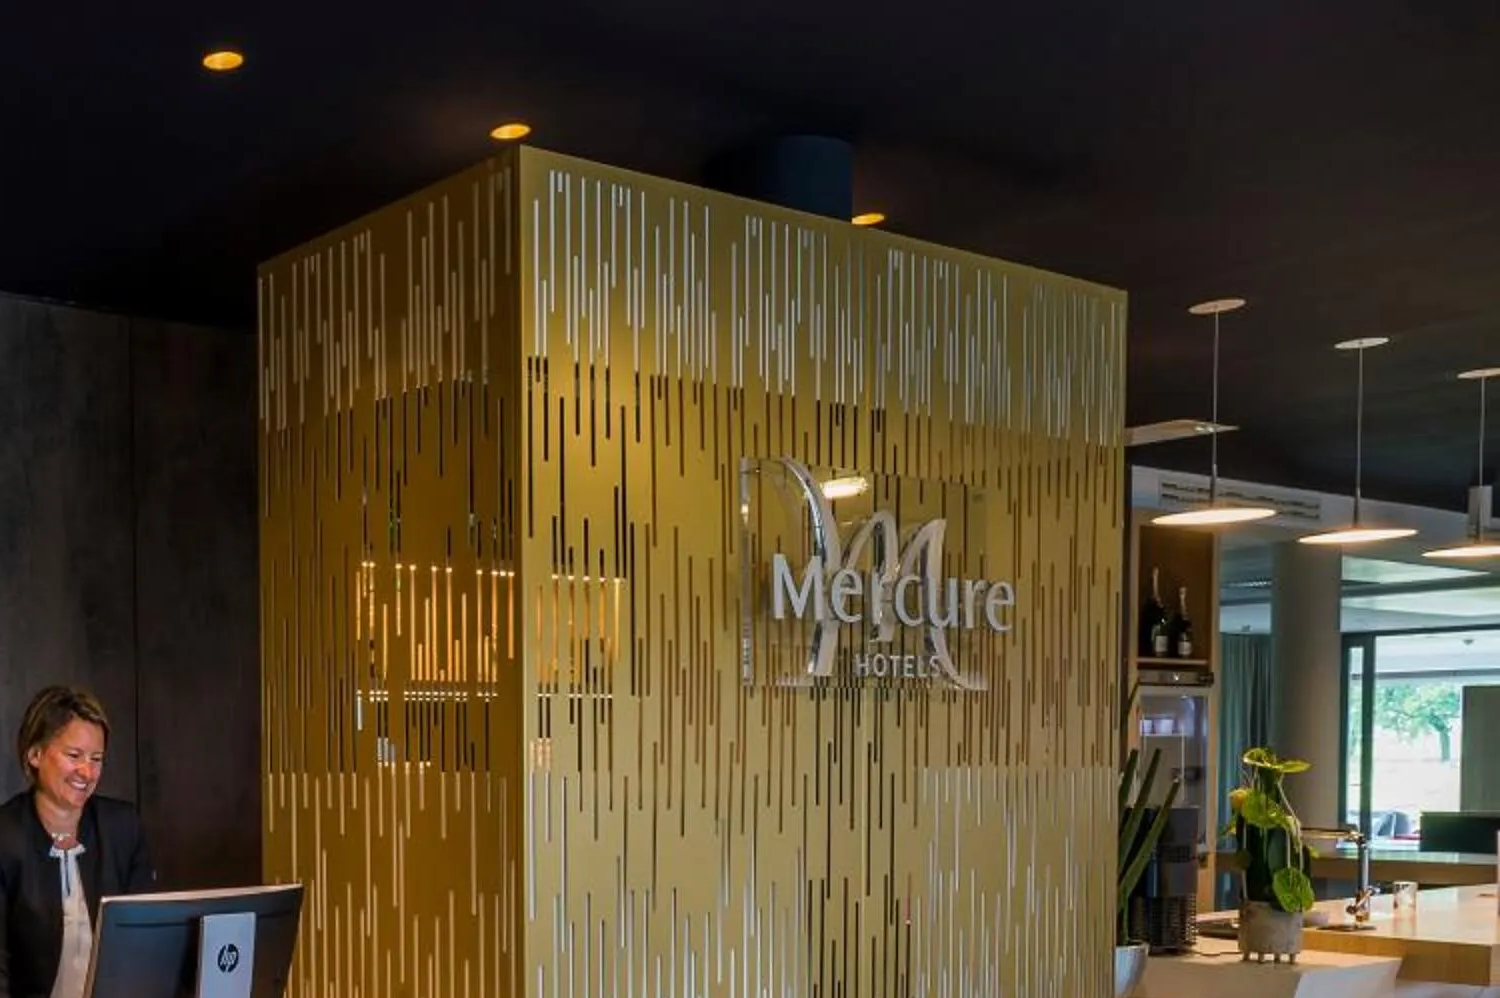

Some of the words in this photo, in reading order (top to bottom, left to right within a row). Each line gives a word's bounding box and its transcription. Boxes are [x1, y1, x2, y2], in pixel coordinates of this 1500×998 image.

[772, 553, 1015, 632] Mercure
[855, 654, 940, 679] HOTELS
[218, 944, 239, 973] hp
